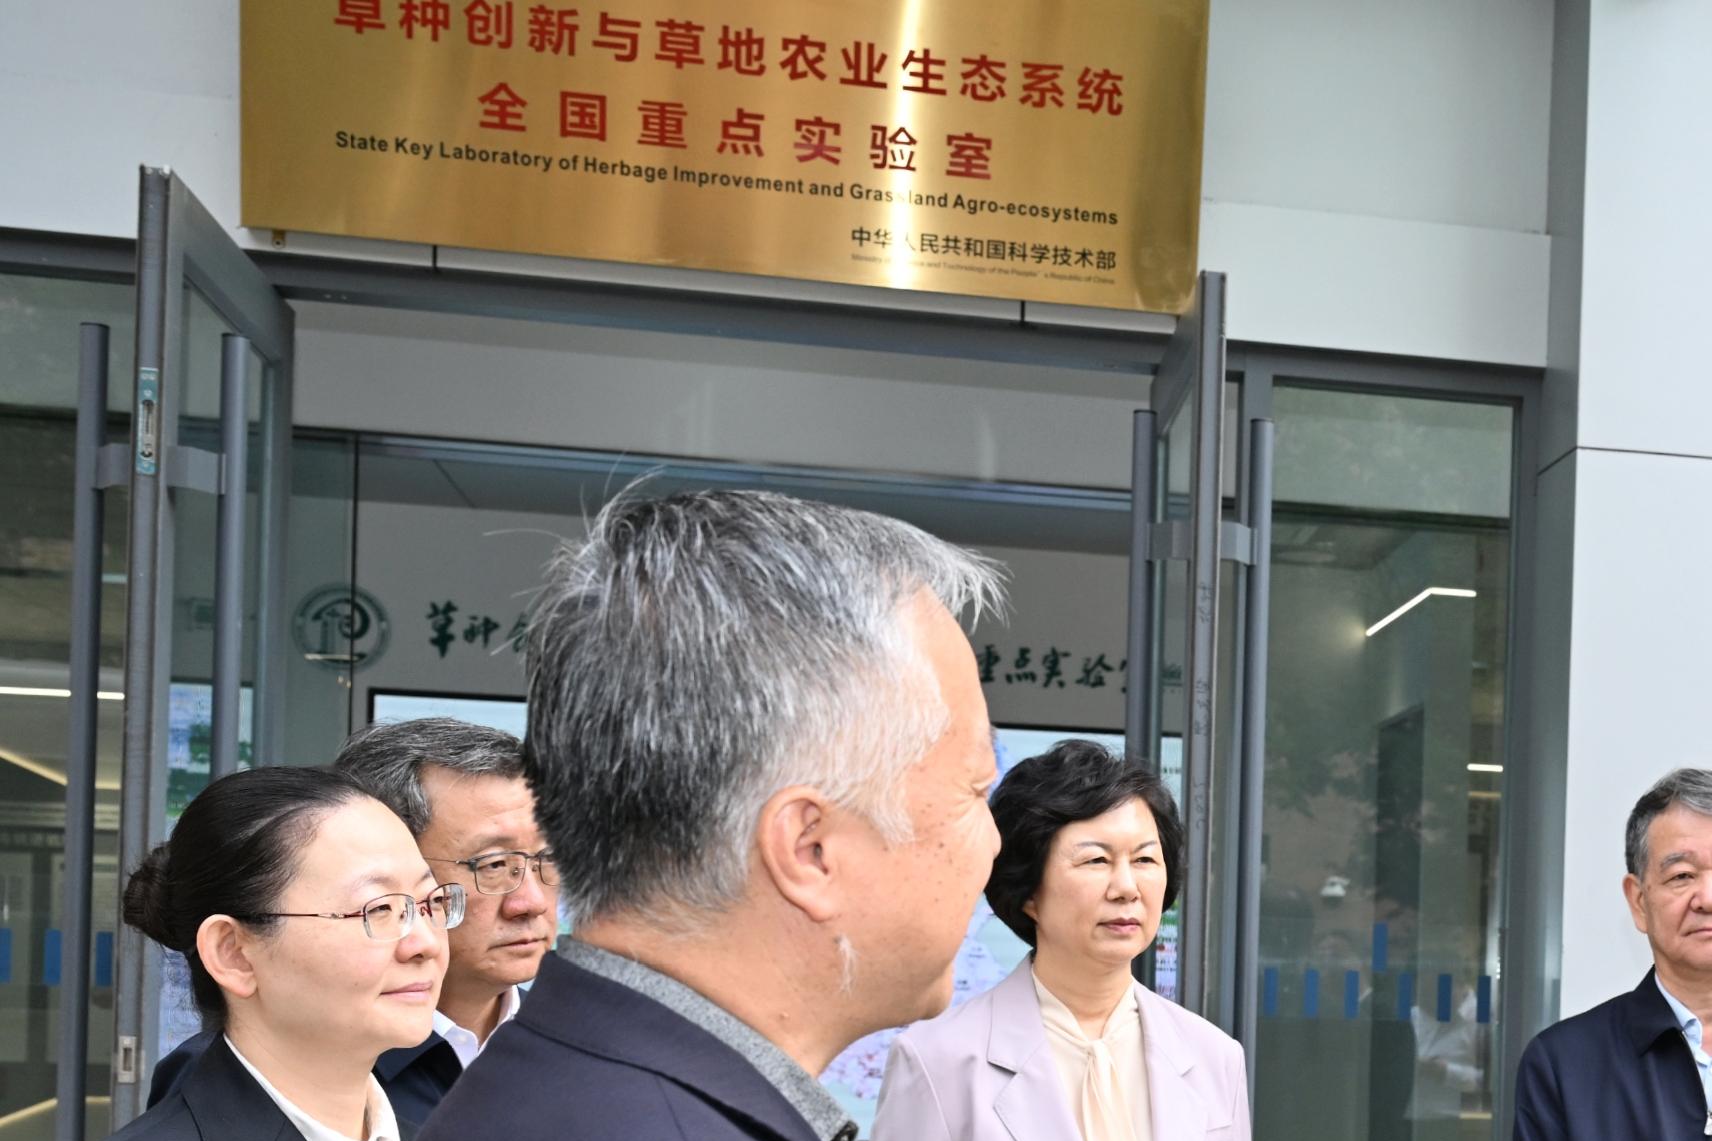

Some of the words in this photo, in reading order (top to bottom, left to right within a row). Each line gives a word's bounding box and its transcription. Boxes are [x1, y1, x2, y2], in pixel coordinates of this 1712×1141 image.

[334, 0, 1125, 117] 草种创新与草地农业生态系统
[336, 131, 389, 152] State
[394, 137, 434, 160] Key
[439, 142, 553, 172] Laboratory
[558, 155, 579, 171] of
[584, 156, 668, 183] Herbage
[673, 166, 804, 194] Improvement
[808, 182, 844, 198] and
[849, 183, 948, 208] Grasland
[952, 194, 1118, 225] Agro-ecosystems
[478, 82, 994, 180] 全国重点实验室
[851, 226, 1117, 271] 中华人民共和国科学技术部
[977, 643, 1127, 694] 重点实验
